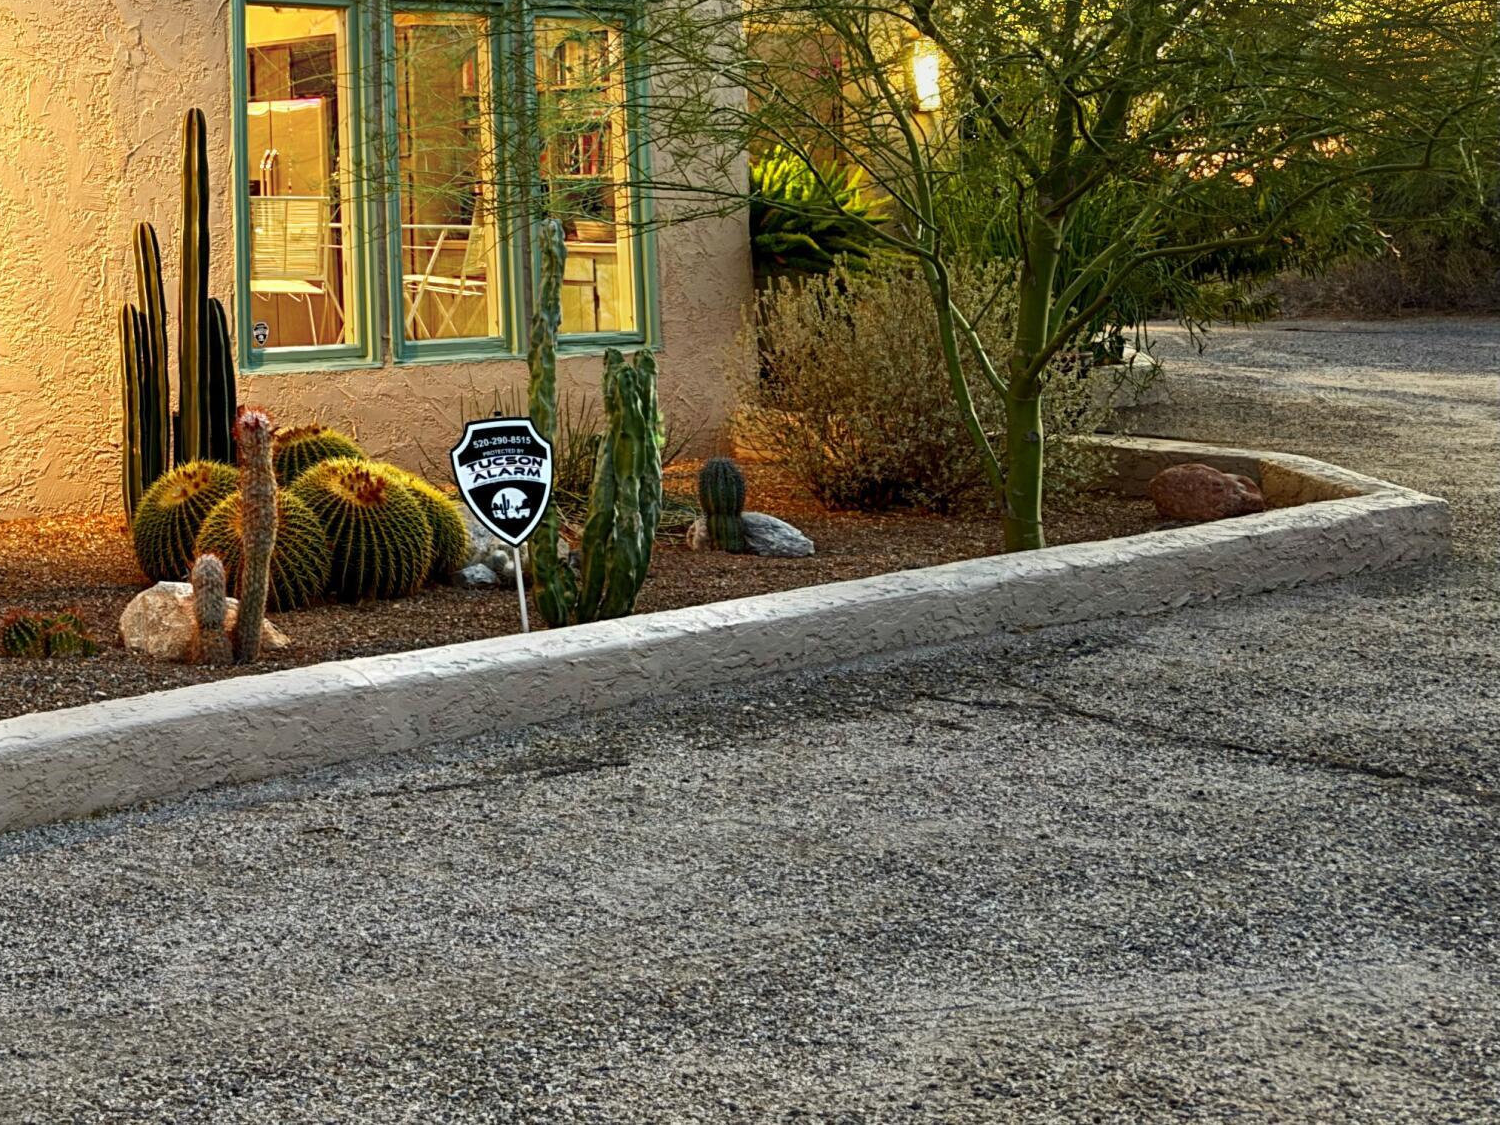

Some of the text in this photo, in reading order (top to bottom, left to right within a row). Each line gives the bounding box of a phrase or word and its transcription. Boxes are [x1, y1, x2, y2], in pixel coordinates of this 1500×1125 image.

[473, 435, 531, 449] 520-290-8515
[482, 448, 516, 457] PROTECTED
[466, 456, 543, 473] TUCSON
[473, 466, 541, 483] ALARM
